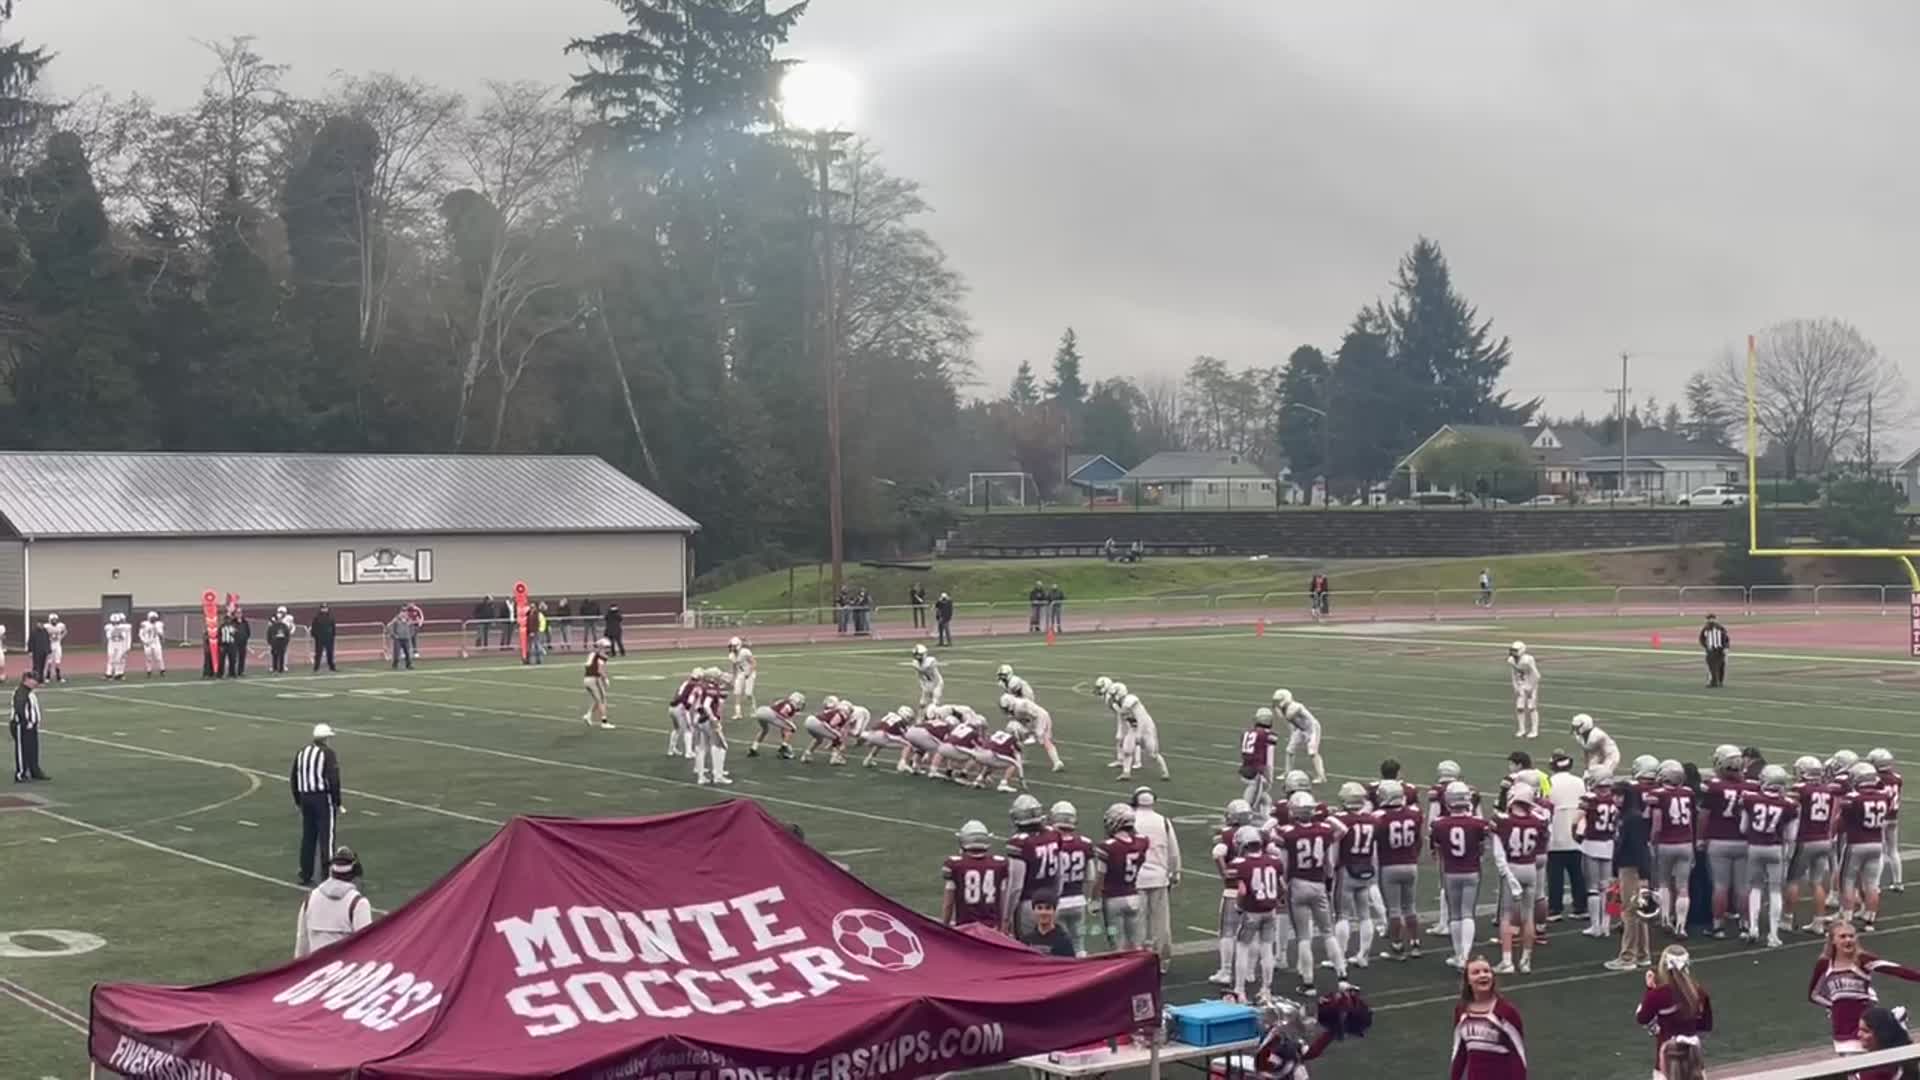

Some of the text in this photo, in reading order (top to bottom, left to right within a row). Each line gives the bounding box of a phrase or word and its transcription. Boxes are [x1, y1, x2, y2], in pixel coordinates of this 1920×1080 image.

[1241, 731, 1257, 753] 12
[1669, 797, 1691, 825] 45
[1752, 803, 1783, 832] 37
[1863, 801, 1887, 828] 52
[1351, 824, 1373, 853] 17
[1389, 820, 1414, 848] 66
[1450, 827, 1465, 857] 9
[1508, 827, 1537, 857] 46
[1296, 836, 1324, 868] 24
[964, 870, 996, 904] 84
[1251, 866, 1277, 900] 40
[494, 885, 807, 977] MONTE
[505, 946, 870, 1037] SOCCER
